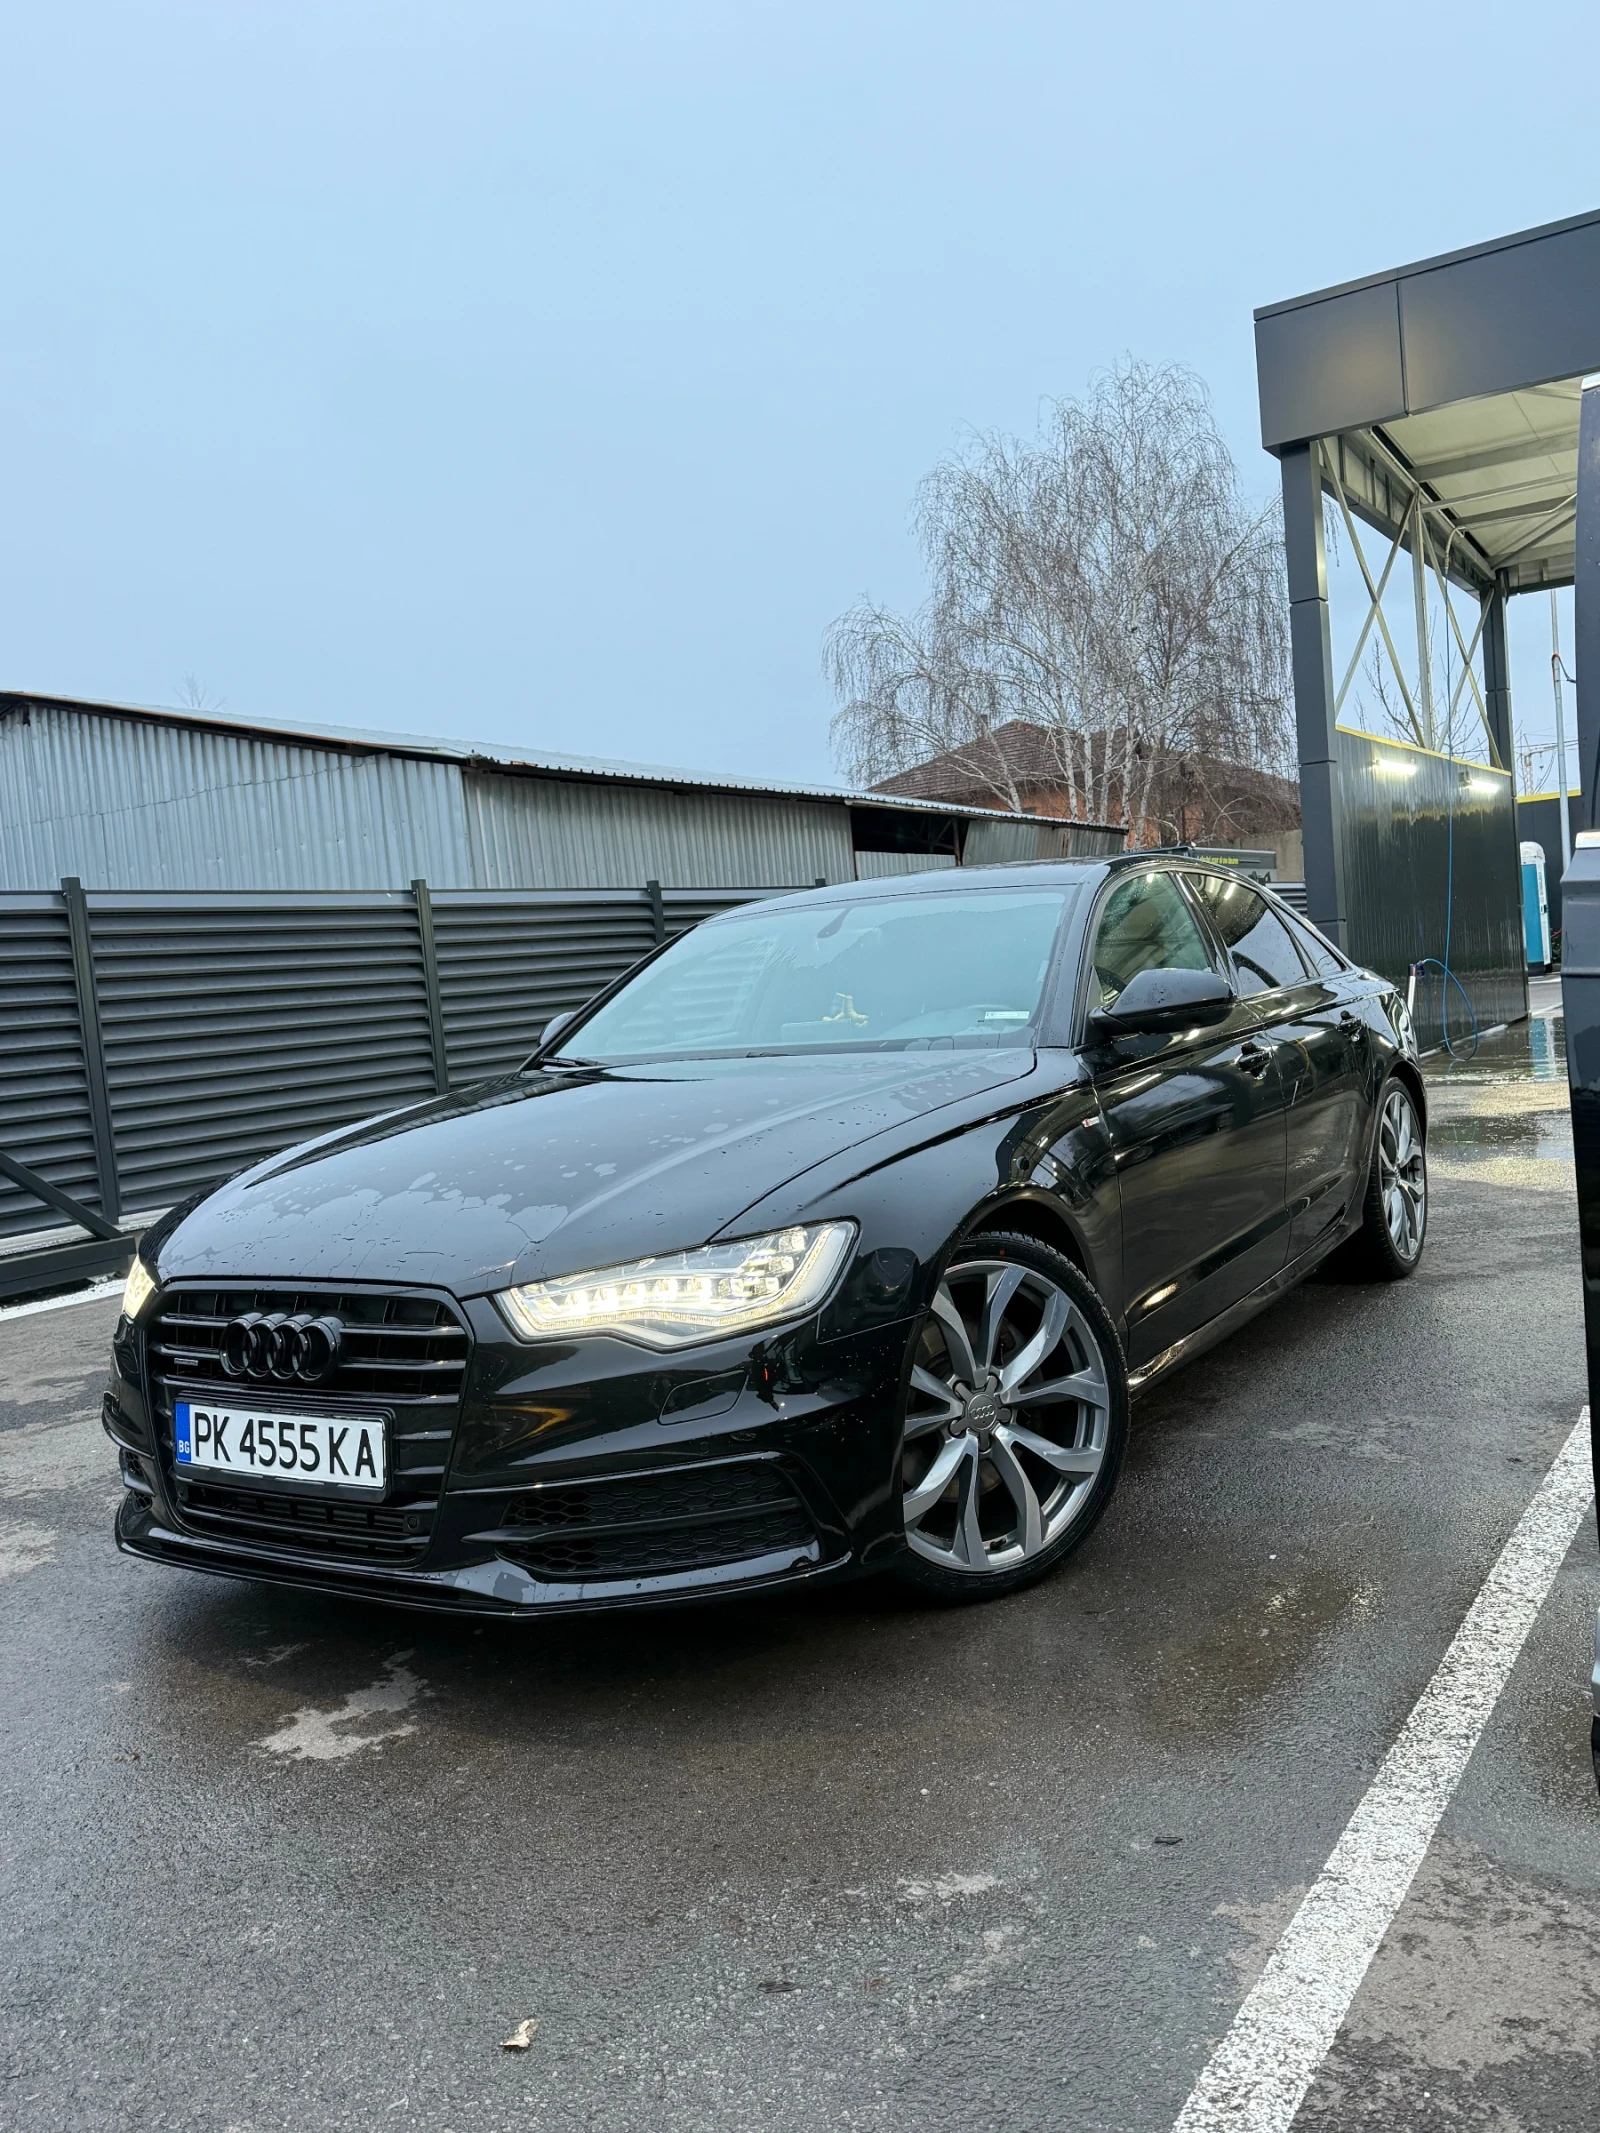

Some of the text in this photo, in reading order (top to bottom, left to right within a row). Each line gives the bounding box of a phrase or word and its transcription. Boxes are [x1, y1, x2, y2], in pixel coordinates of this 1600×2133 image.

[178, 1440, 190, 1454] BG
[194, 1411, 377, 1478] PK 4555 KA
